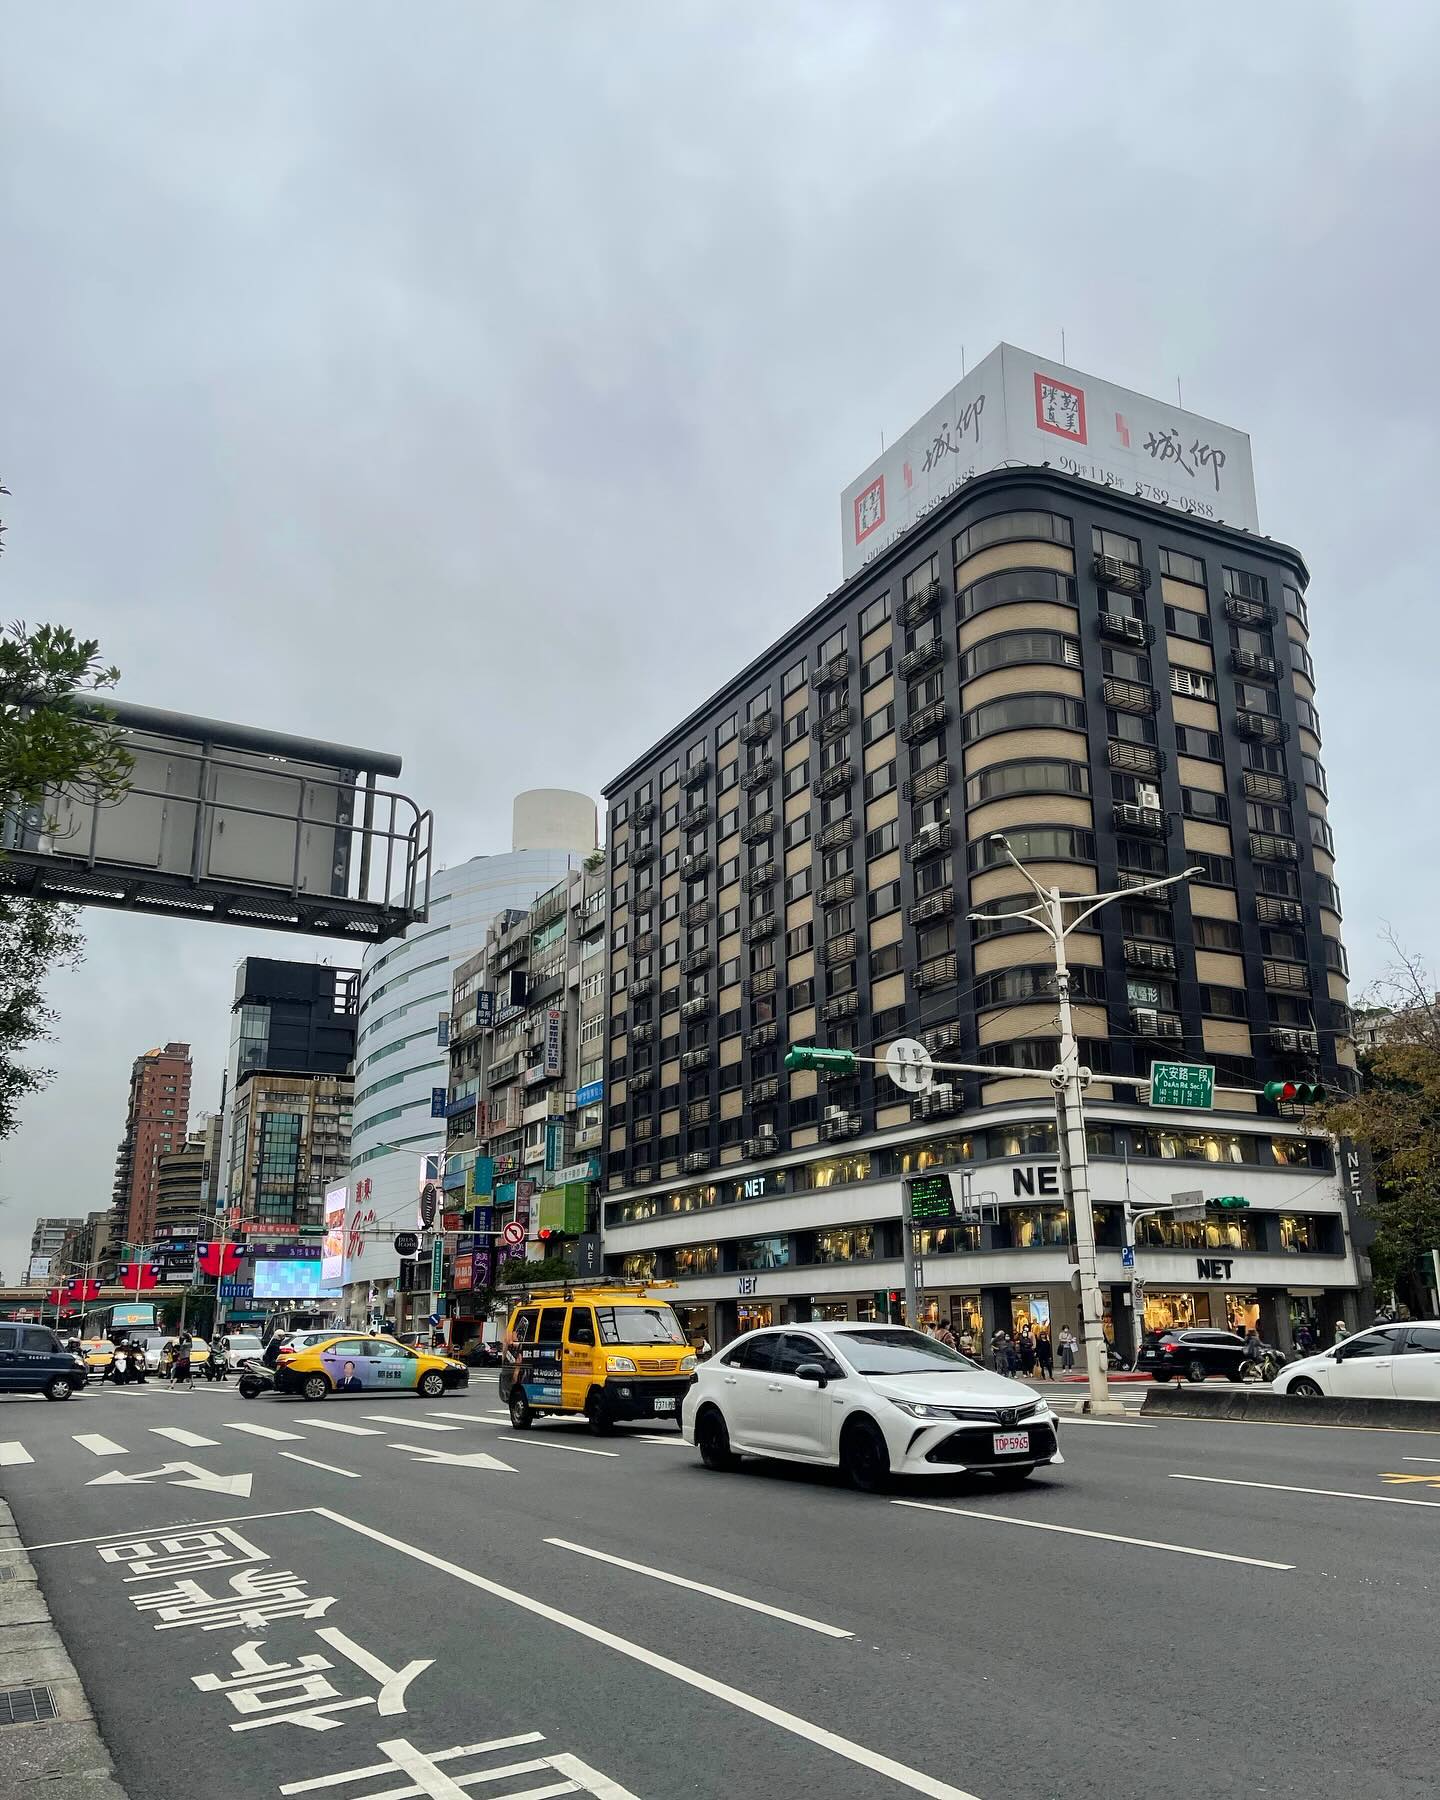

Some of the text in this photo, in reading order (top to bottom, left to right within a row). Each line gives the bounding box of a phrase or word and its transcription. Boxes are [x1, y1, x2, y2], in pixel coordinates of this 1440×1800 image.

[1159, 1066, 1208, 1082] 大安路一段
[744, 1178, 766, 1198] NET
[1012, 1167, 1059, 1197] NE
[1347, 1152, 1362, 1208] NET
[587, 1242, 595, 1269] NET
[1197, 1259, 1234, 1281] NET
[737, 1276, 757, 1294] NET
